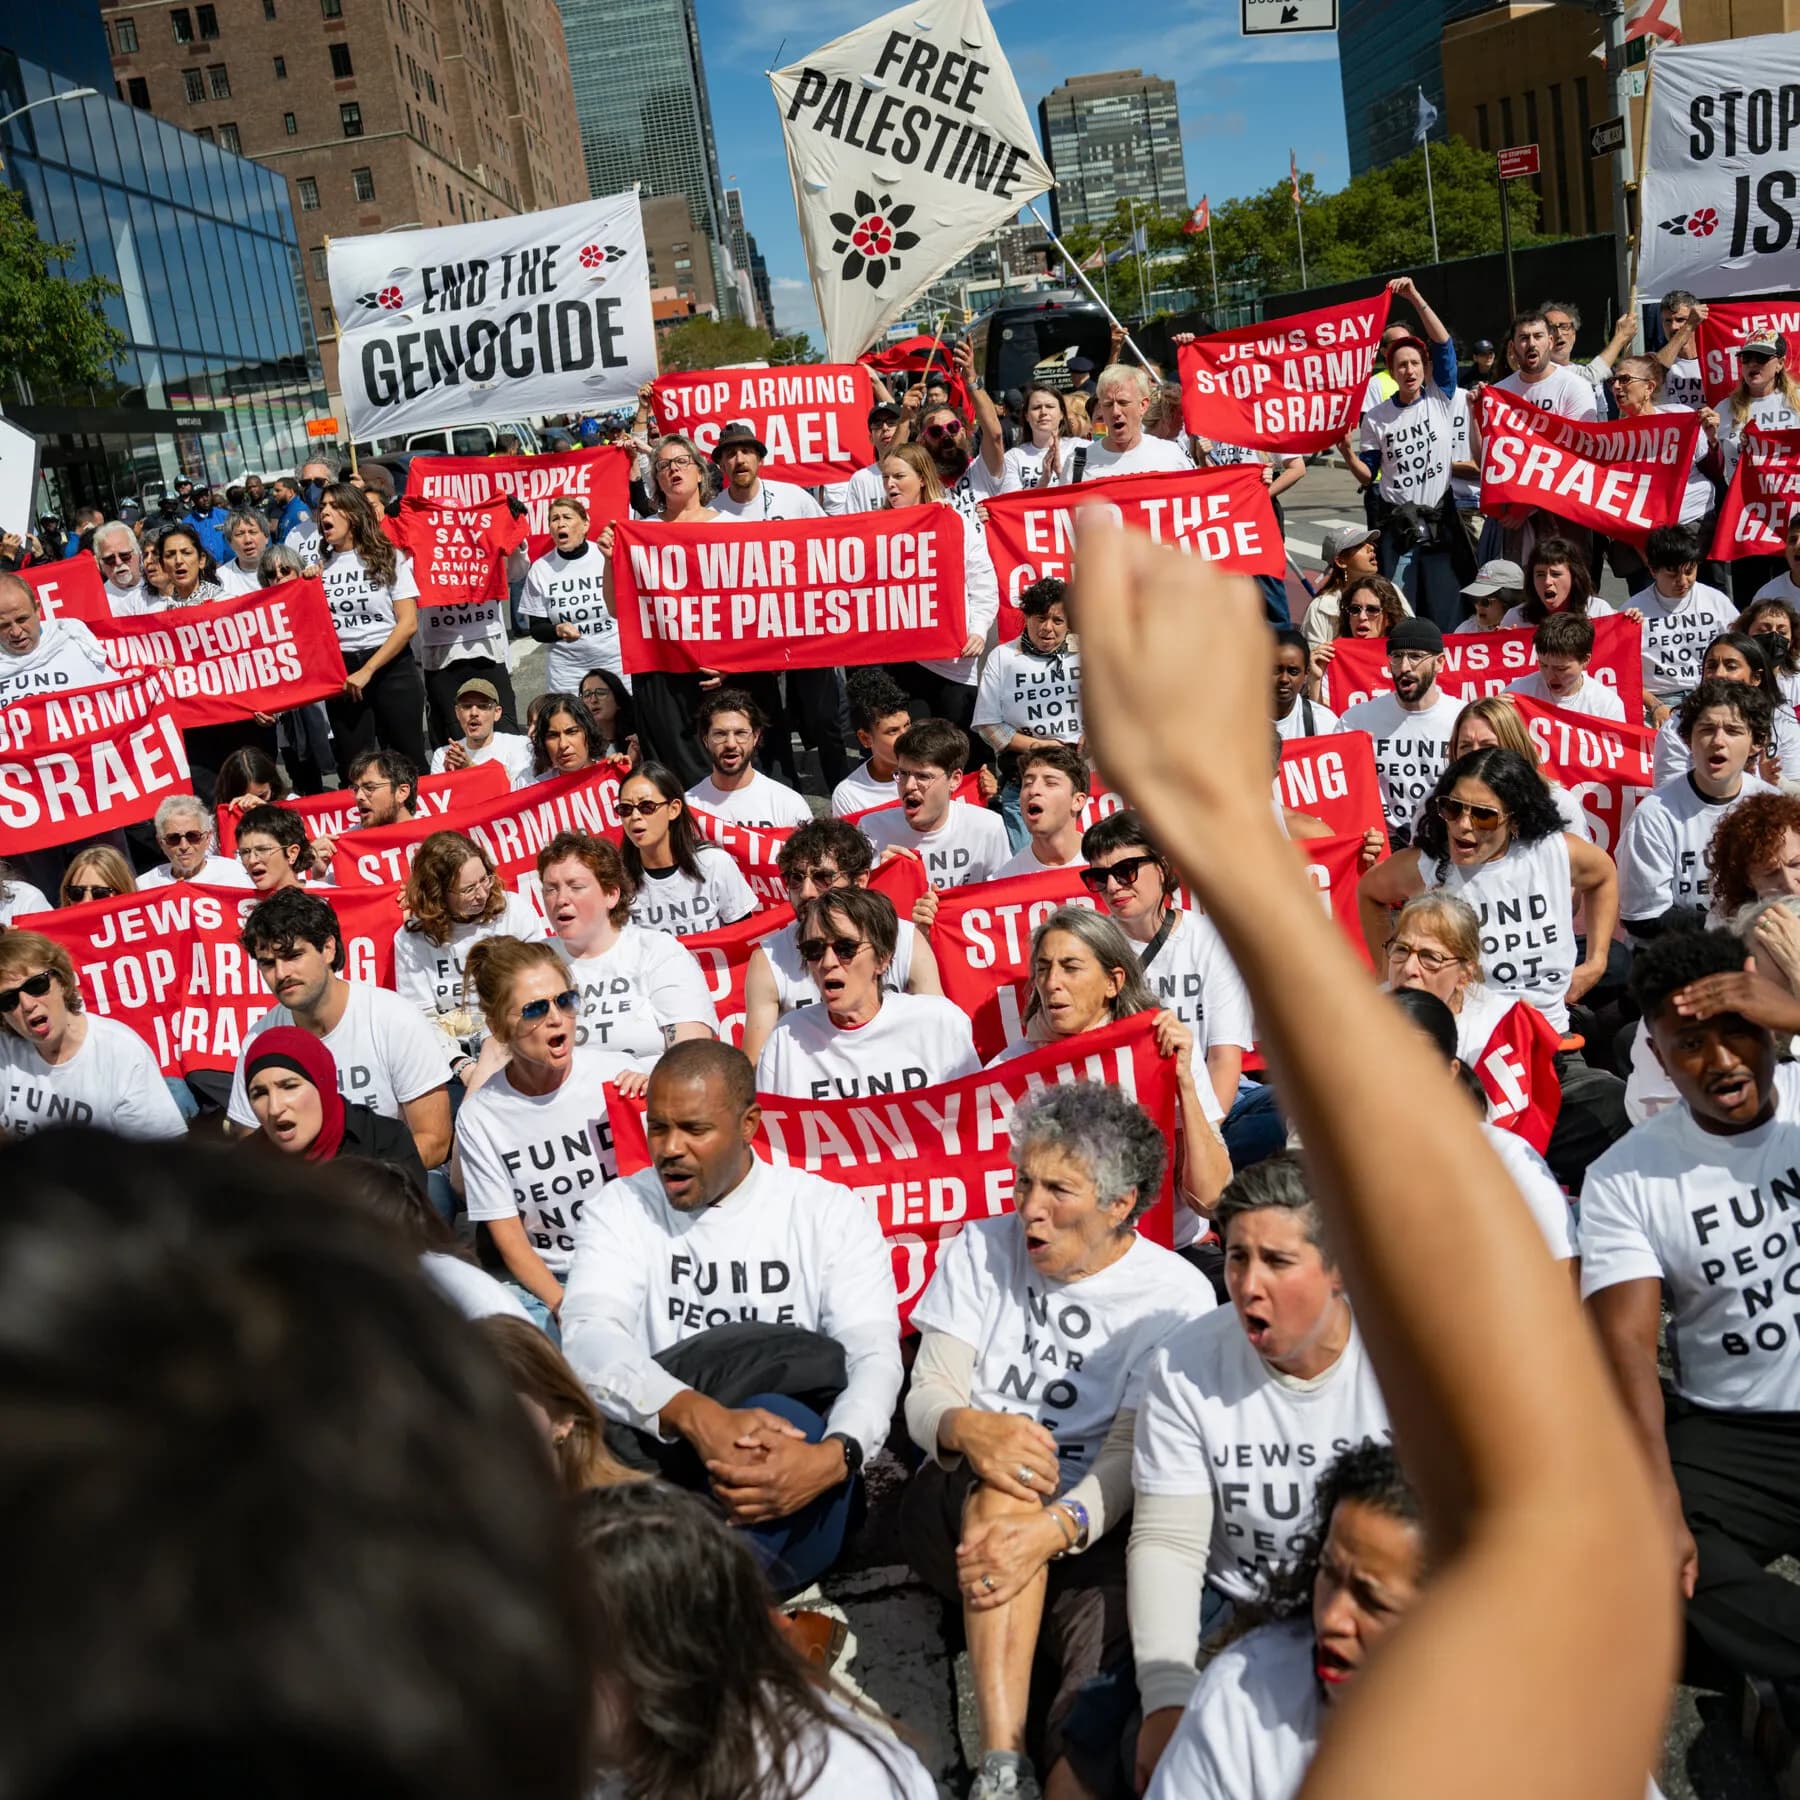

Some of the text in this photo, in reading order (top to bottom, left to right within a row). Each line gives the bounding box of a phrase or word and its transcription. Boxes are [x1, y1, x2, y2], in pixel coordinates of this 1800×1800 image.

[874, 30, 990, 114] FREE
[787, 67, 1031, 200] PALESTINE
[1690, 83, 1800, 161] STOP
[1730, 170, 1800, 258] IS
[421, 245, 561, 315] END THE
[1219, 314, 1375, 363] JEWS SAY
[1732, 312, 1800, 338] JEW
[361, 297, 629, 407] GENOCIDE
[662, 375, 855, 421] STOP ARMING
[1195, 363, 1271, 399] STOP
[1254, 395, 1352, 434] ISRAEL
[1480, 396, 1549, 436] STOP
[1553, 425, 1681, 465] ARMING
[678, 411, 852, 466] SAEL
[495, 463, 593, 501] PEOPLE
[1480, 435, 1653, 530] ISRAEL
[428, 511, 492, 528] JEWS
[436, 528, 483, 544] SAY
[1140, 494, 1230, 546] THE
[430, 561, 489, 575] ARMING
[433, 546, 486, 560] STOP
[629, 531, 937, 591] NO WAR NO ICE
[325, 581, 379, 598] EOPLE
[430, 574, 485, 587] ISRAEL
[550, 591, 602, 609] PEOPL
[174, 601, 295, 662] PEOPLE
[430, 609, 494, 628] BOMBS
[558, 605, 604, 624] NOT
[578, 619, 613, 635] MBS
[638, 583, 939, 641] FREE PALESTINE
[1649, 611, 1715, 633] FUND
[0, 671, 69, 694] FUND
[172, 641, 303, 699] BOMBS
[45, 669, 176, 743] ARMIN
[1014, 685, 1077, 703] PEOPL
[1027, 699, 1079, 721] NOT
[1021, 719, 1080, 737] BOMB
[1528, 716, 1625, 770] STOP
[90, 896, 223, 949] JEWS
[631, 896, 710, 925] FUND
[1478, 893, 1547, 927] UND
[73, 948, 178, 1015] TOP
[1492, 956, 1543, 984] OT
[811, 1066, 928, 1100] FUND
[513, 1163, 619, 1204] PEOPL
[1691, 1167, 1800, 1246] FUN
[671, 1254, 790, 1296] FUND
[1027, 1286, 1092, 1340] NO
[1021, 1334, 1084, 1373] WAR
[997, 1364, 1078, 1410] NO
[1213, 1443, 1316, 1468] JEWS
[1221, 1482, 1300, 1520] FU
